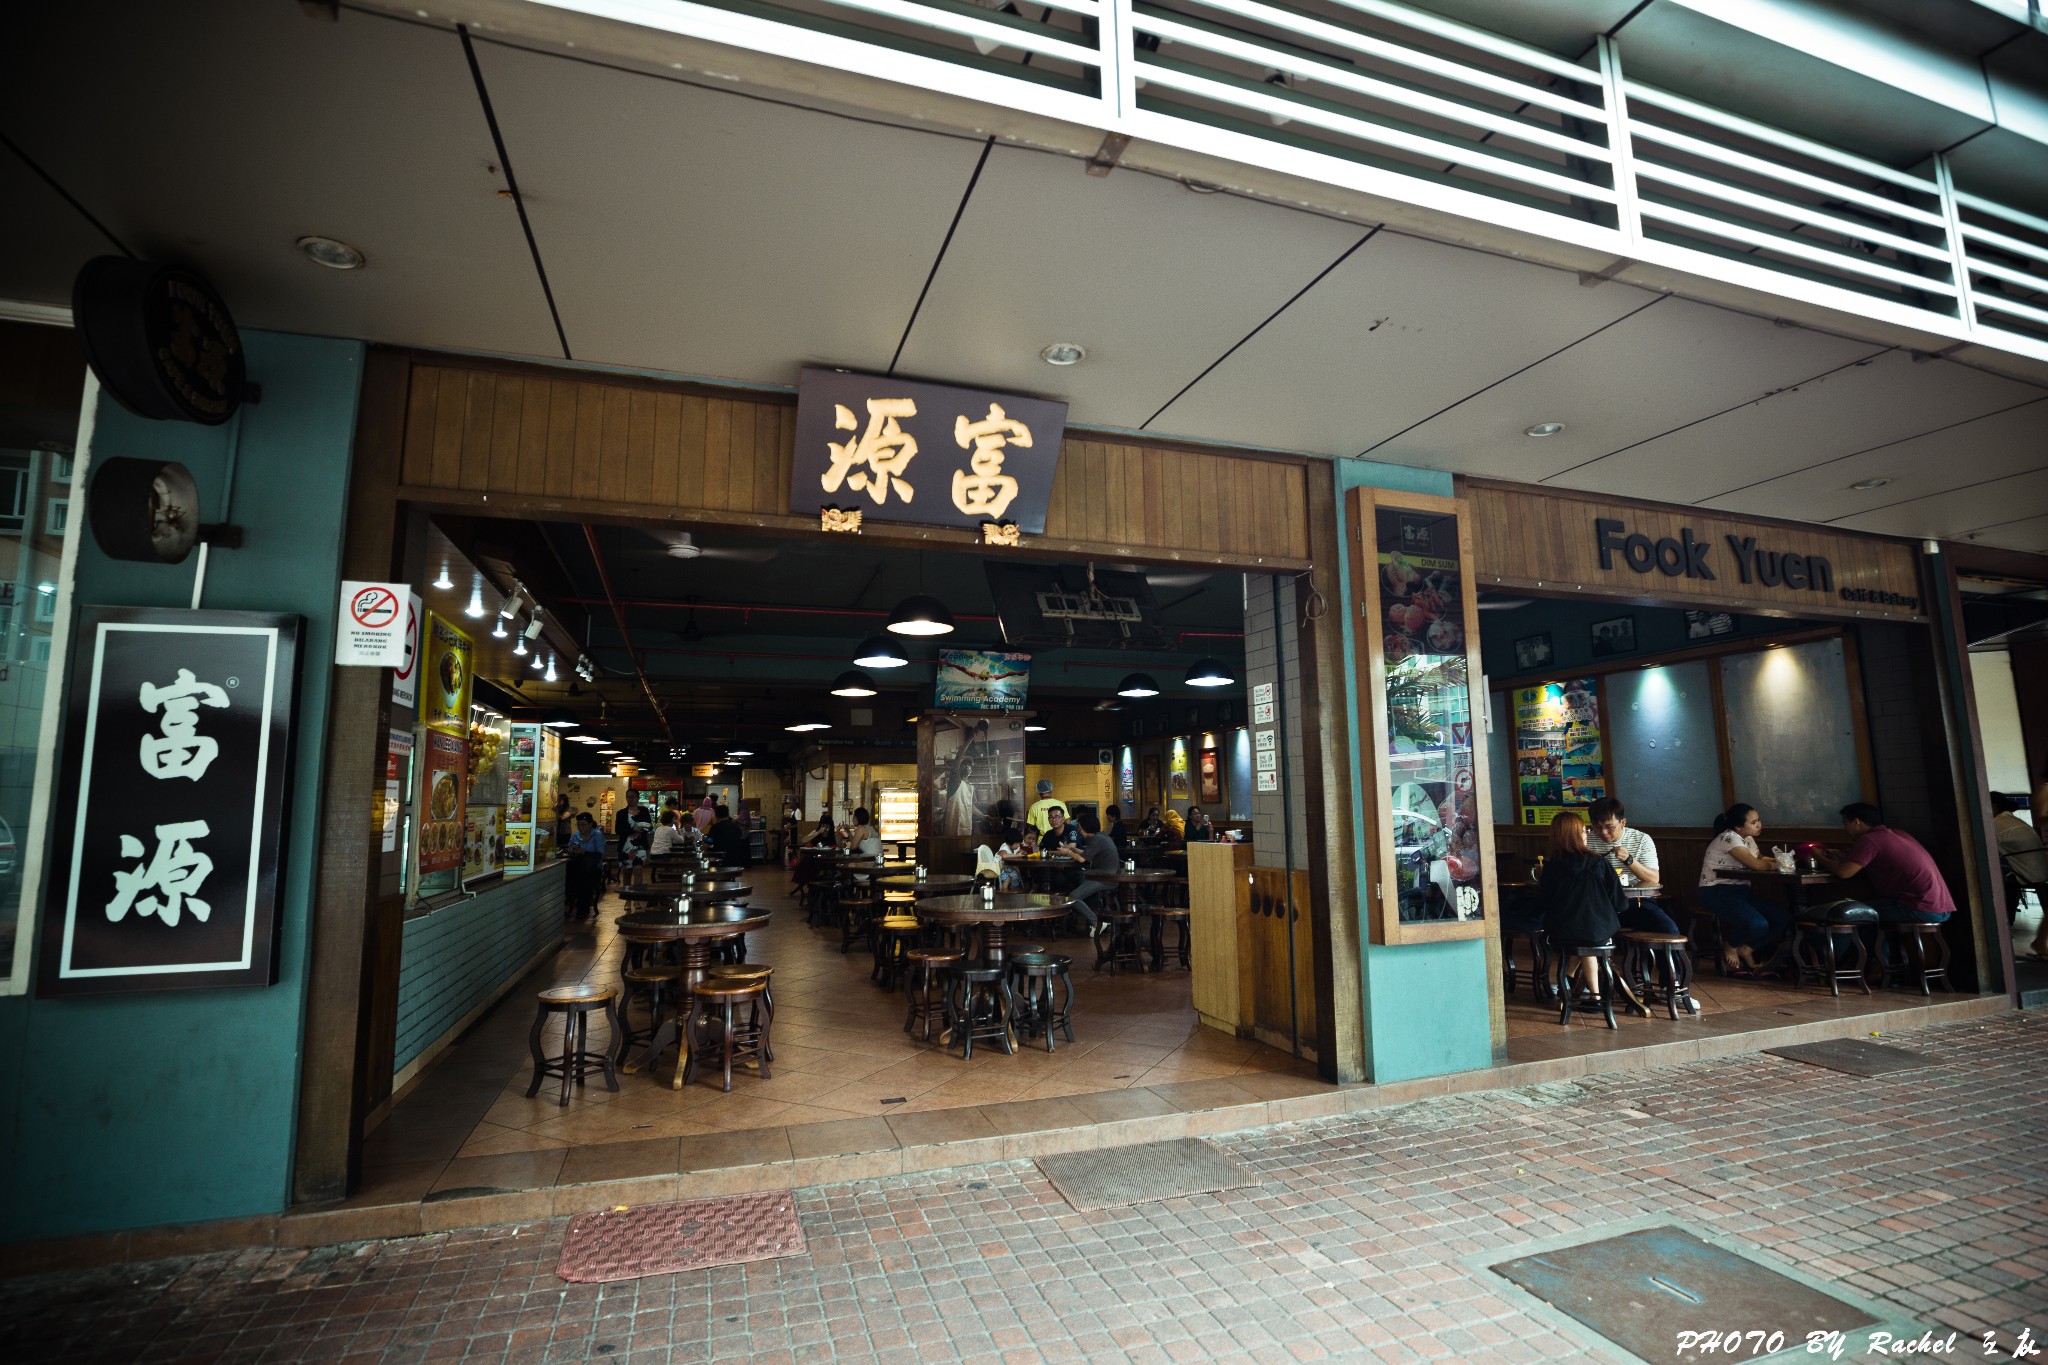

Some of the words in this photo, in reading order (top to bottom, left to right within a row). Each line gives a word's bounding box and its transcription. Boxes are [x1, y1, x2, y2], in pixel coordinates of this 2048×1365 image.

[1421, 558, 1437, 568] DIM
[1438, 560, 1455, 570] SUM
[1595, 518, 1717, 581] Fook
[1726, 534, 1834, 593] Yuen
[1883, 592, 1919, 609] Bakery
[940, 693, 981, 703] Swimming
[982, 696, 1021, 705] Academy
[105, 668, 231, 928] 富源
